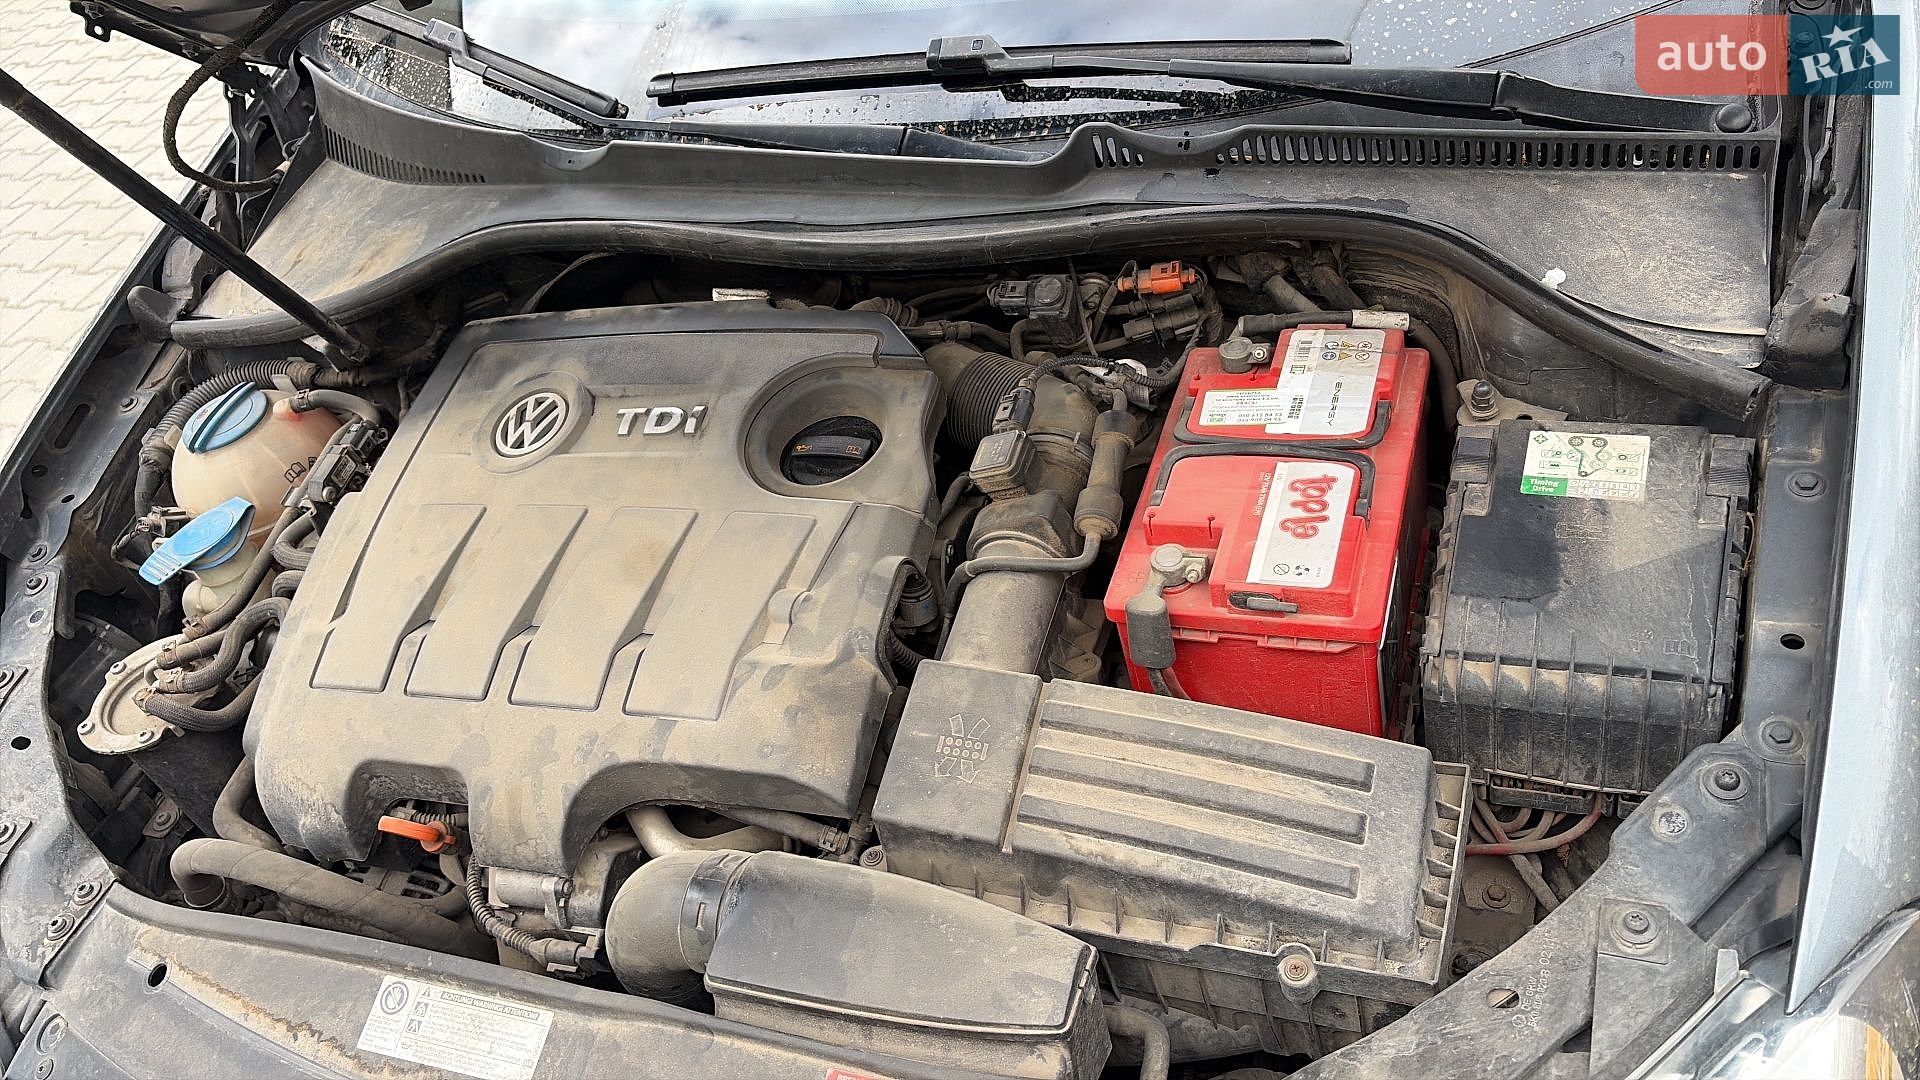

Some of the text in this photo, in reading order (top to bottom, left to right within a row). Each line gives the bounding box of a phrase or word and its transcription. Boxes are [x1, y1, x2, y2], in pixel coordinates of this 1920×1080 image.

[1326, 382, 1343, 426] ENERGY
[1529, 478, 1560, 488] Timing
[1532, 484, 1556, 493] Drive
[1278, 474, 1339, 539] topla
